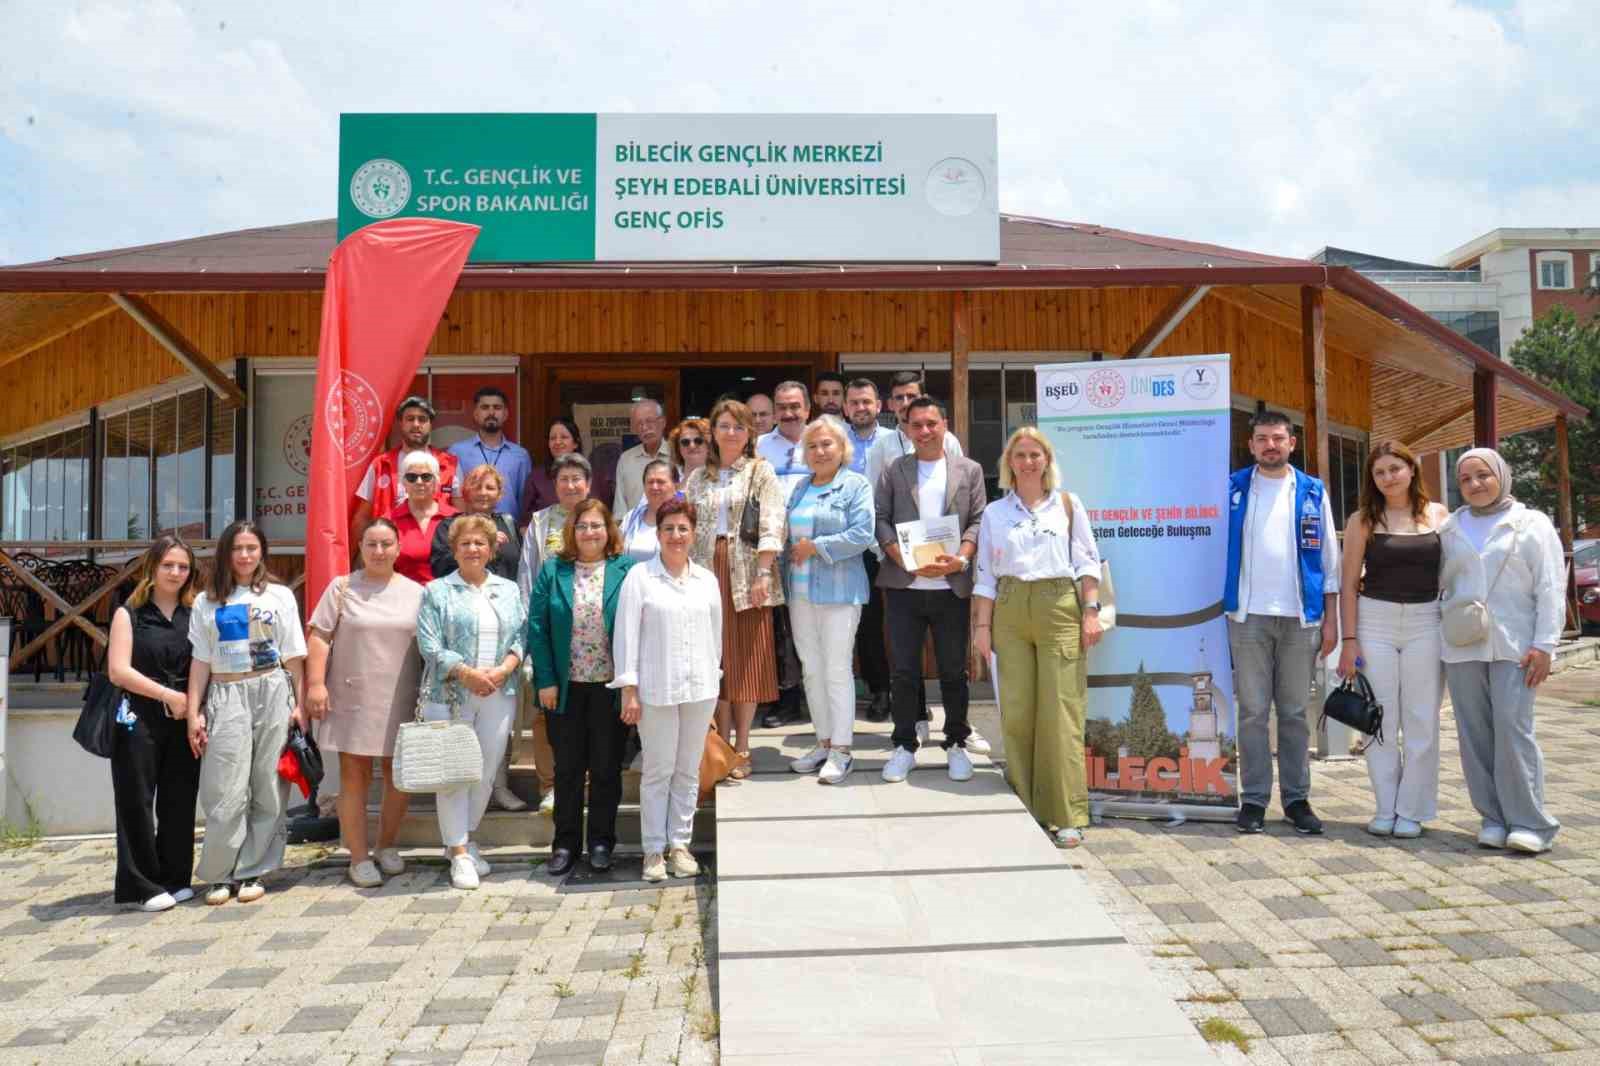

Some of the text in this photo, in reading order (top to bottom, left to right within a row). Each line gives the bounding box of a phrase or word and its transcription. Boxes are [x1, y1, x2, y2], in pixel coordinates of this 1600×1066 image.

[615, 141, 882, 168] BİLECİK GENÇLİK MERKEZİ
[424, 165, 582, 188] T.C. GENÇLİK VE
[615, 174, 905, 200] ŞEYH EDEBALİ ÜNİVERSİTESİ
[417, 191, 588, 211] SPOR BAKANLIĞI
[614, 207, 723, 233] GENÇ OFİS
[256, 502, 293, 516] SPOR
[1118, 524, 1164, 539] Geleceğe
[1167, 523, 1211, 540] Buluşma
[1085, 746, 1233, 796] İLECİK
